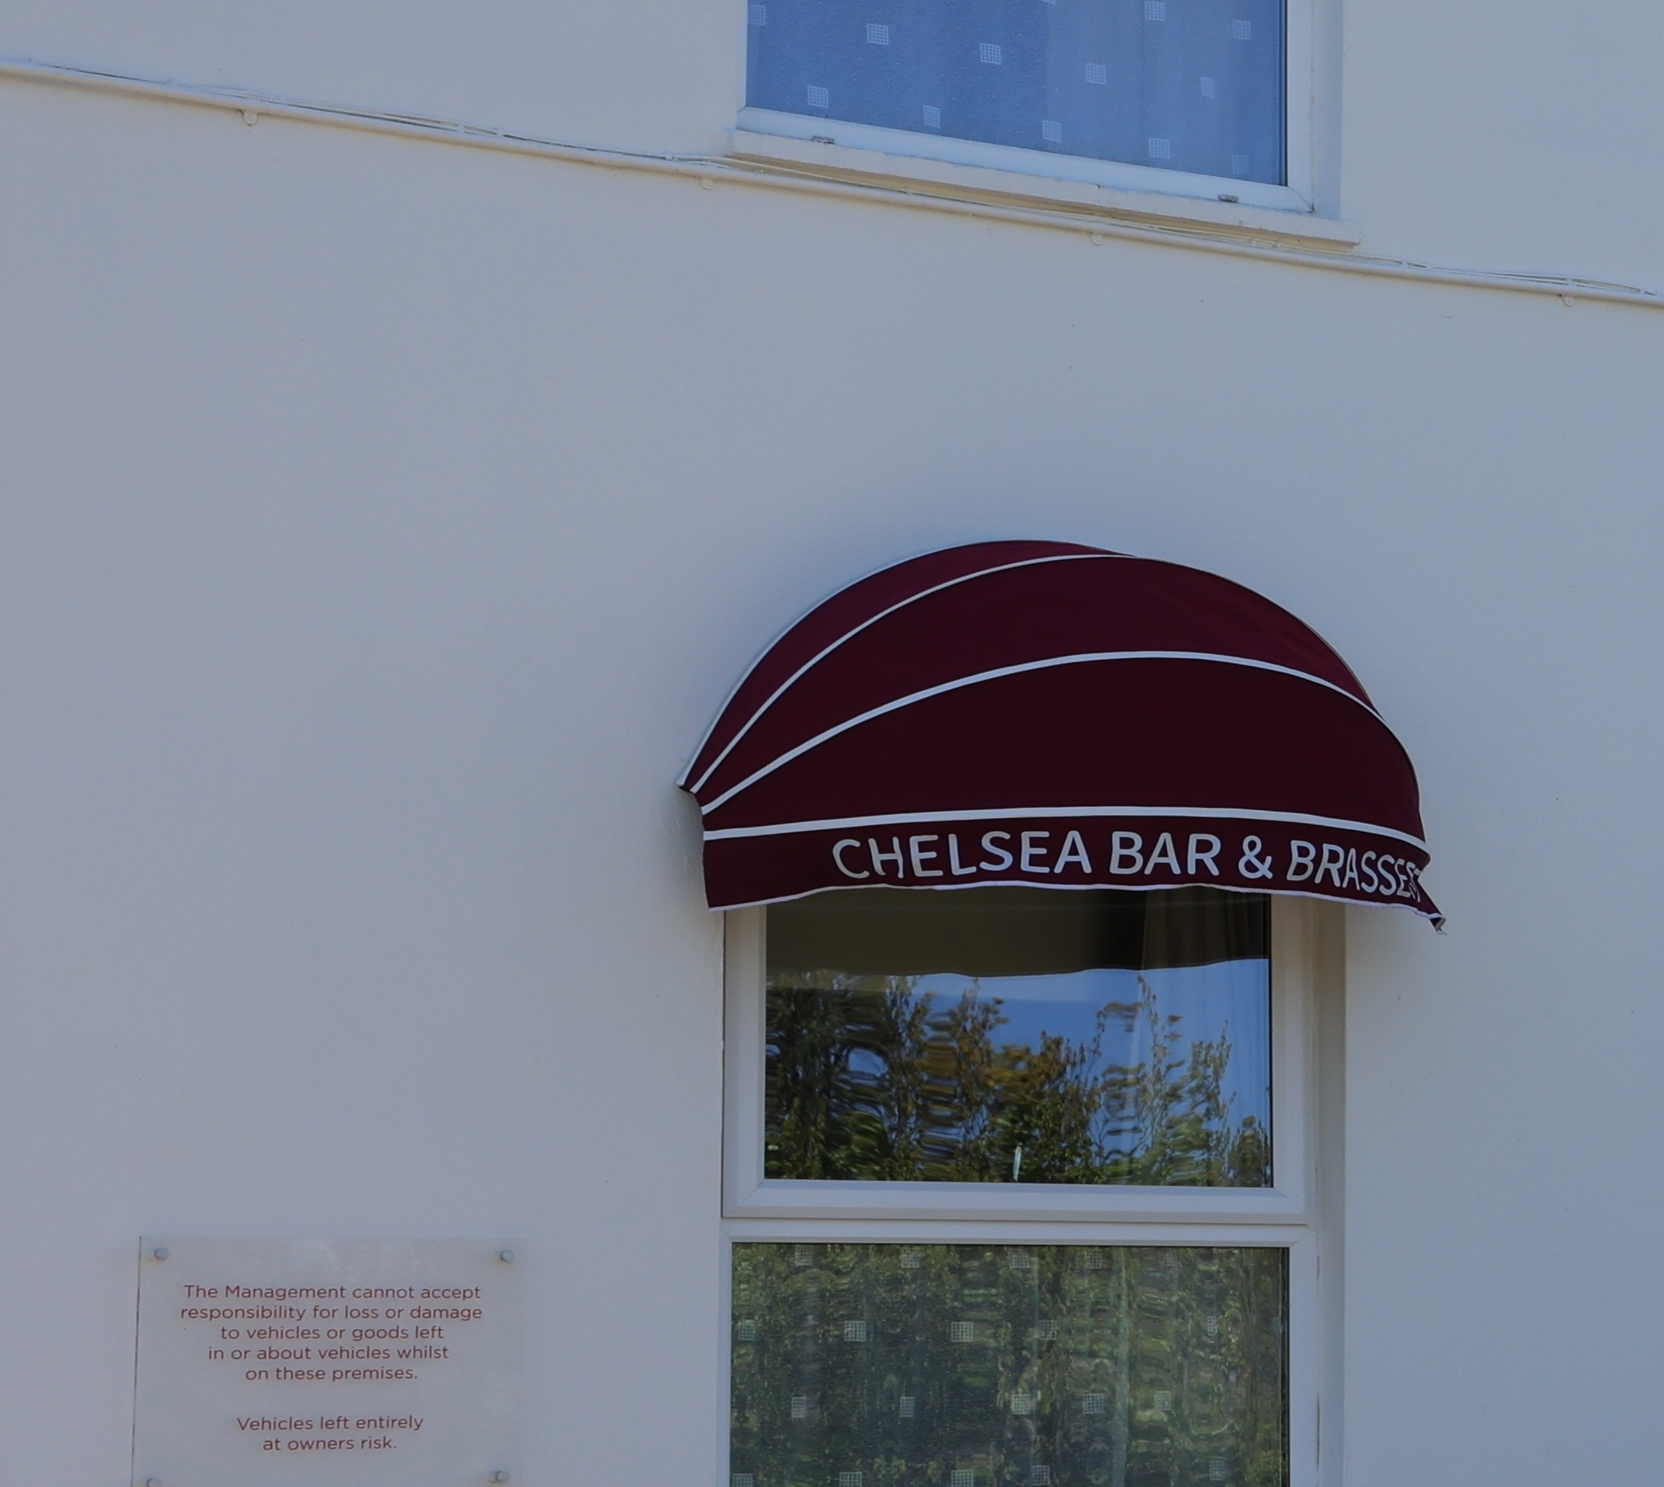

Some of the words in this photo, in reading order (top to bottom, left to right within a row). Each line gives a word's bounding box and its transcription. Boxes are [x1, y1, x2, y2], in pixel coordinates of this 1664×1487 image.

[832, 830, 1093, 880] CHELSEA
[1110, 831, 1221, 877] BAR
[1237, 835, 1274, 881] &
[183, 1284, 219, 1299] The
[225, 1284, 346, 1302] Management
[352, 1286, 415, 1299] cannot
[420, 1286, 481, 1301] accept
[180, 1304, 307, 1322] responsibility
[312, 1304, 339, 1319] for
[344, 1305, 380, 1319] loss
[384, 1308, 405, 1319] or
[409, 1305, 483, 1322] damage
[220, 1326, 240, 1340] to
[246, 1325, 321, 1340] vehicles
[326, 1328, 346, 1340] or
[351, 1325, 409, 1342] goods
[415, 1325, 444, 1339] left
[208, 1345, 225, 1360] in
[230, 1349, 252, 1360] or
[256, 1345, 312, 1360] about
[317, 1345, 391, 1360] vehicles
[396, 1345, 449, 1359] whilst
[245, 1369, 269, 1381] on
[275, 1366, 326, 1381] these
[332, 1365, 418, 1383] premises.
[236, 1416, 314, 1431] Vehicles
[320, 1415, 350, 1430] left
[355, 1414, 424, 1432] entirely
[262, 1438, 282, 1451] at
[287, 1439, 355, 1451] owners
[360, 1435, 397, 1450] risk.
